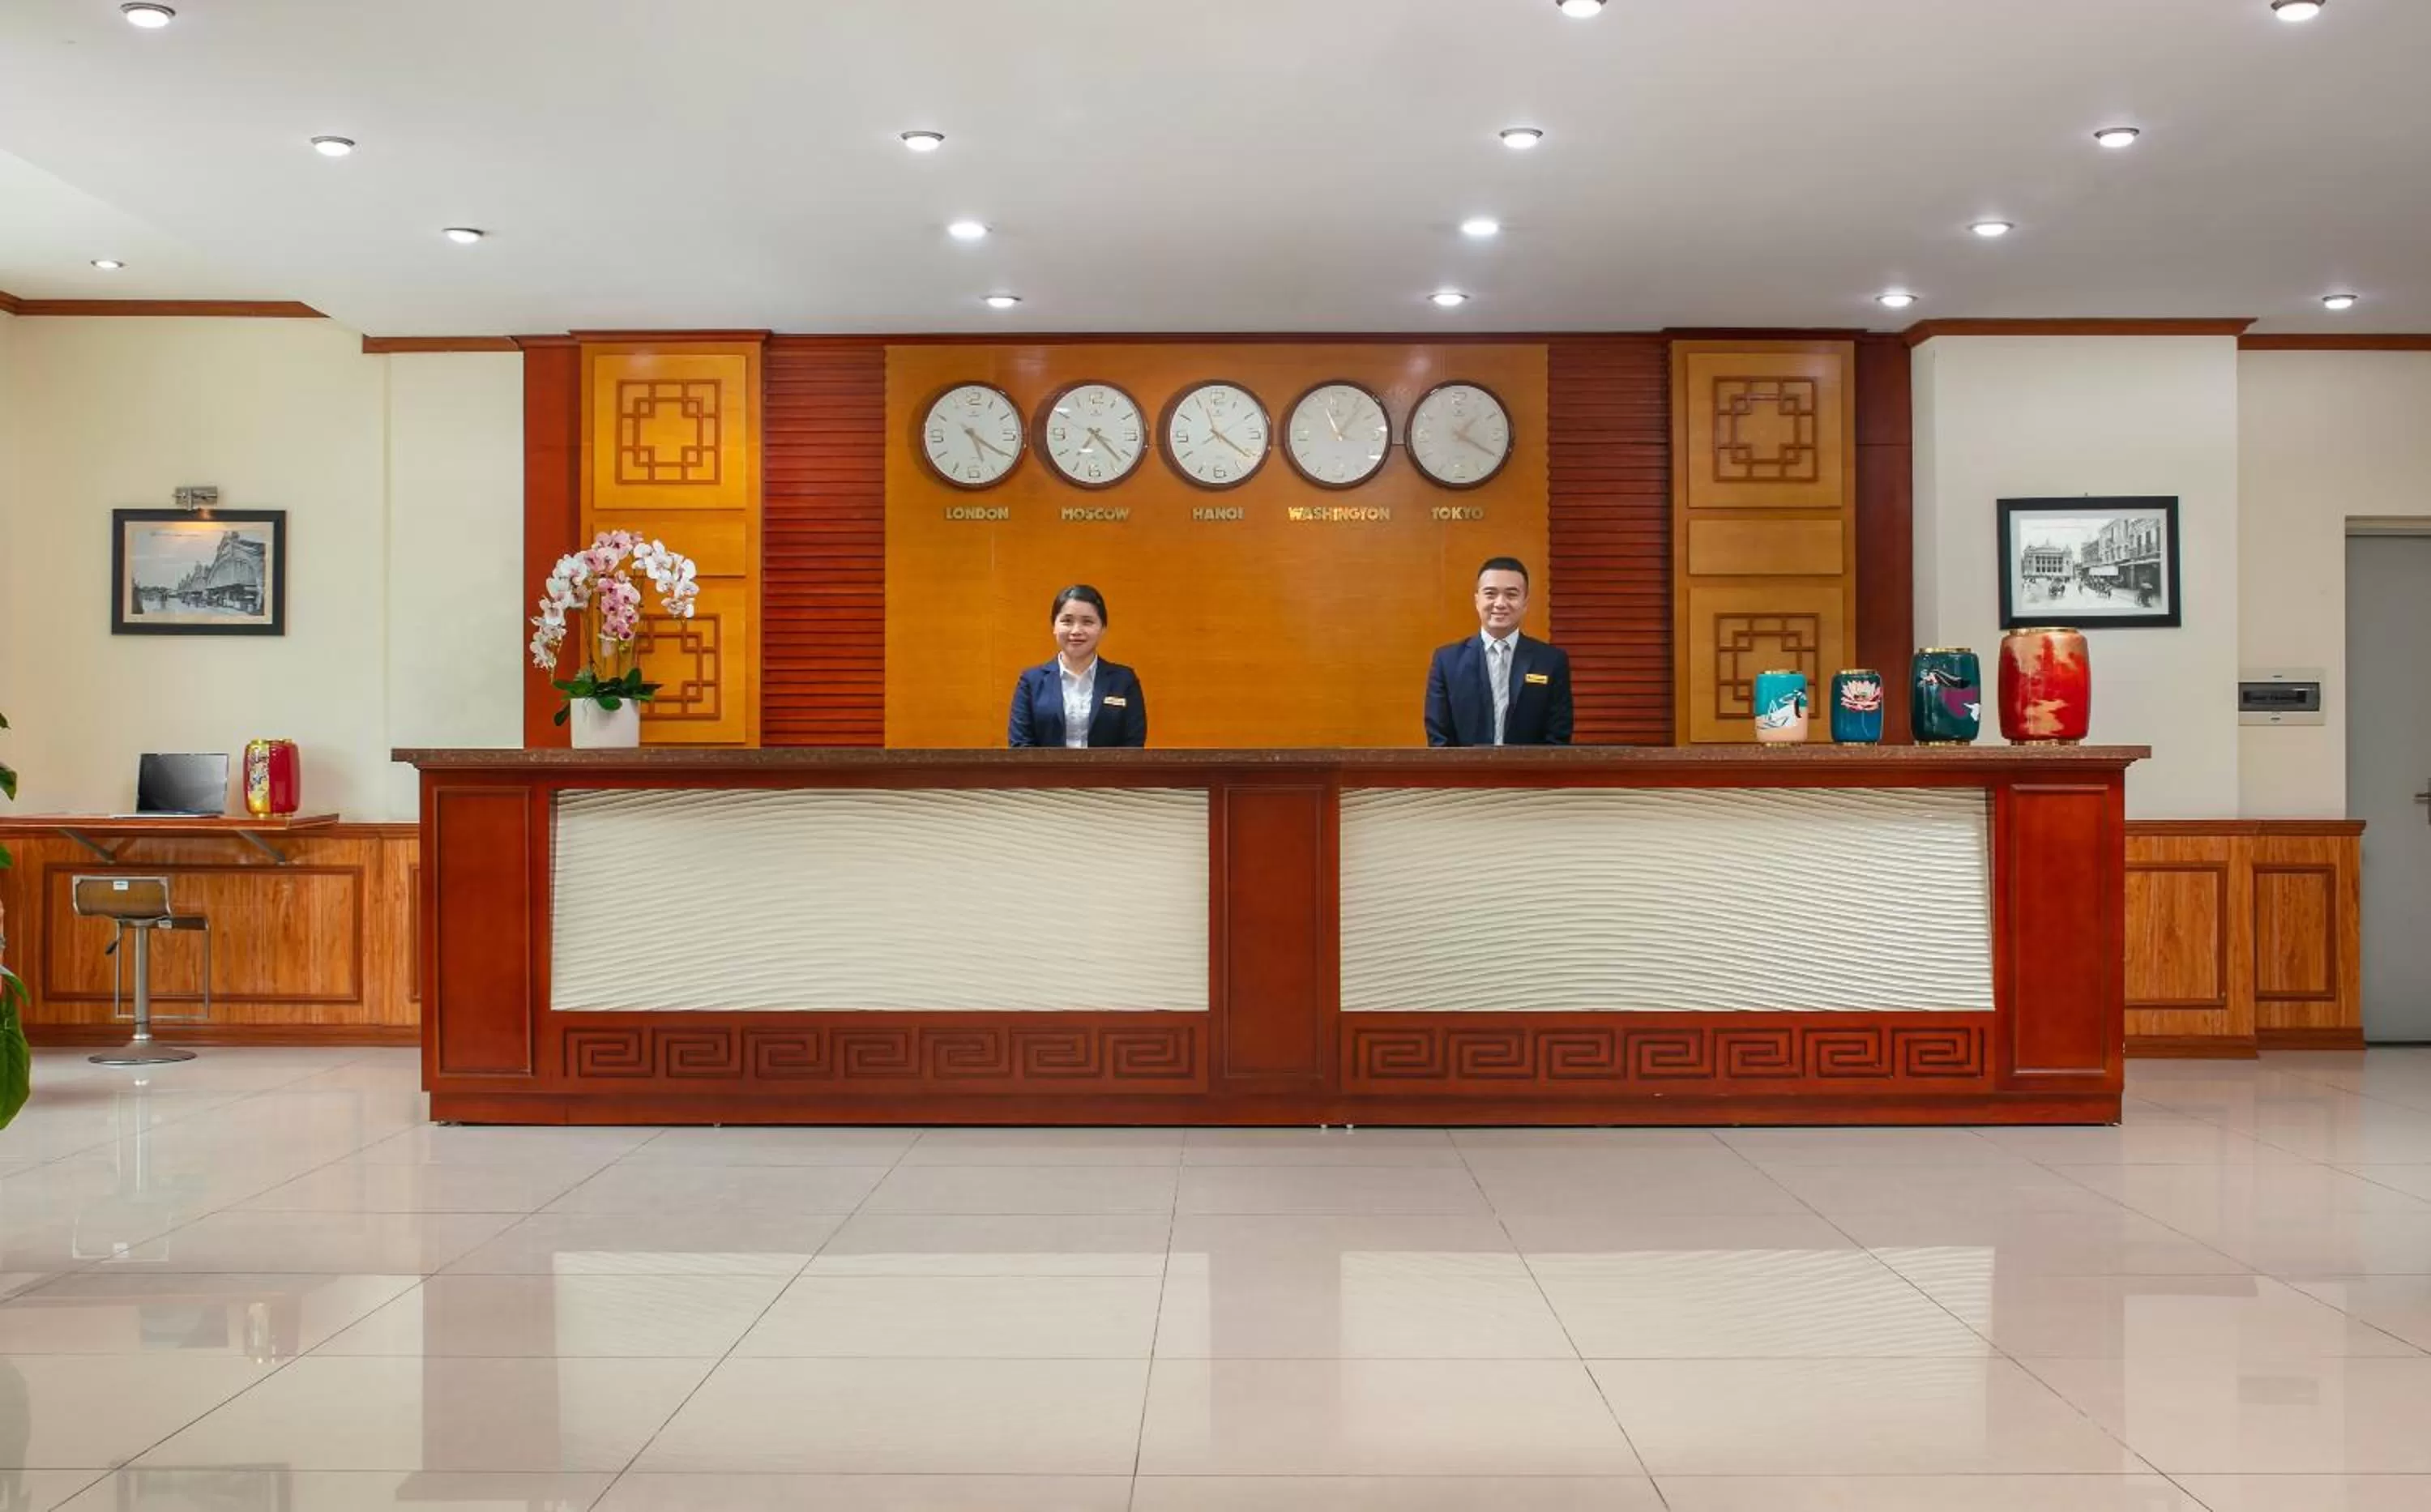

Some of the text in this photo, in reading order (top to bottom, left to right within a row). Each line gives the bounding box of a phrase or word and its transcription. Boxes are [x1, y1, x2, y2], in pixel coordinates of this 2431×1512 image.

[946, 507, 1009, 519] LONDON
[1061, 507, 1130, 520] MOSCOW
[1192, 507, 1244, 520] HANOI
[1288, 506, 1391, 520] WASHINGTON
[1432, 507, 1484, 519] TOKYO
